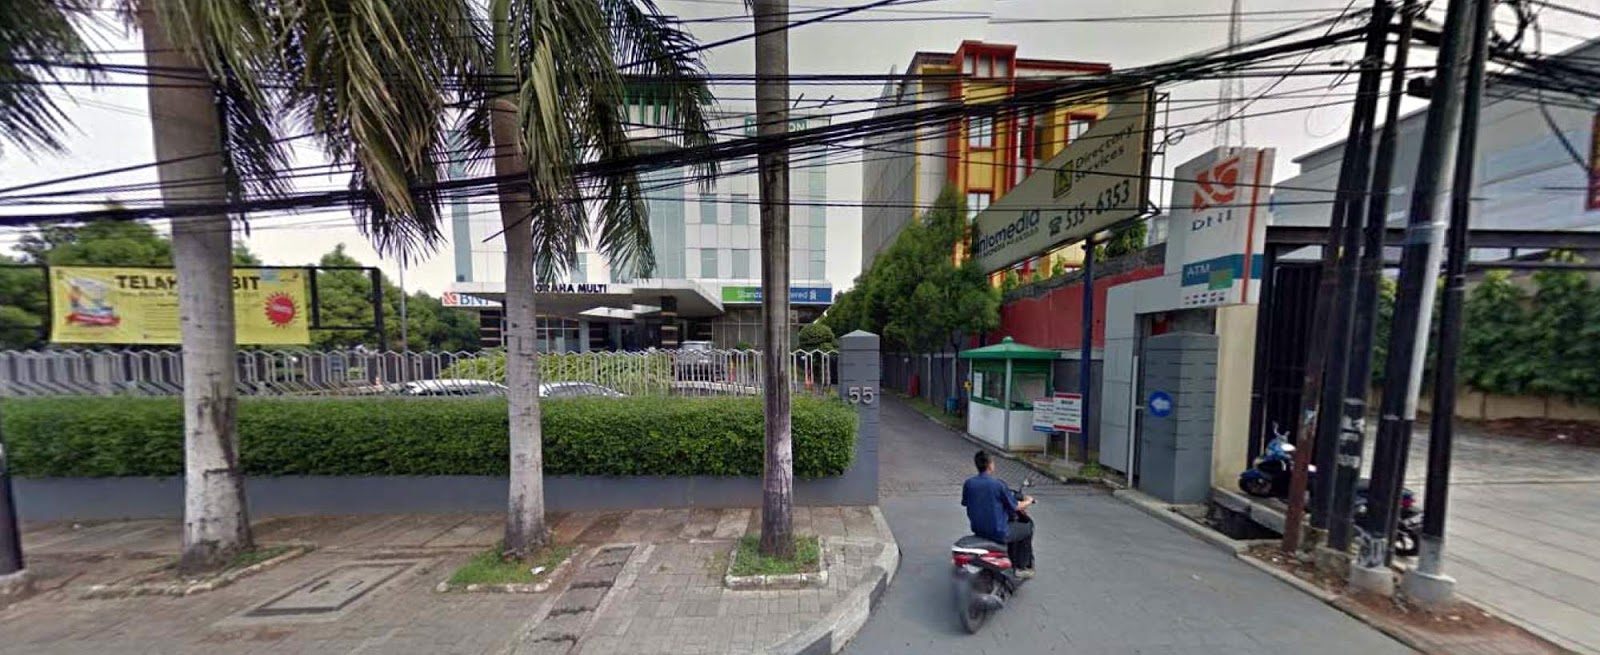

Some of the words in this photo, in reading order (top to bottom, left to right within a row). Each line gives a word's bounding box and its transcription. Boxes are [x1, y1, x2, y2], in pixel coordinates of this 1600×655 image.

[1076, 124, 1134, 168] Directory
[1075, 145, 1124, 182] Services
[1186, 264, 1210, 279] ATM
[577, 284, 607, 292] MULTI
[849, 386, 874, 404] 55
